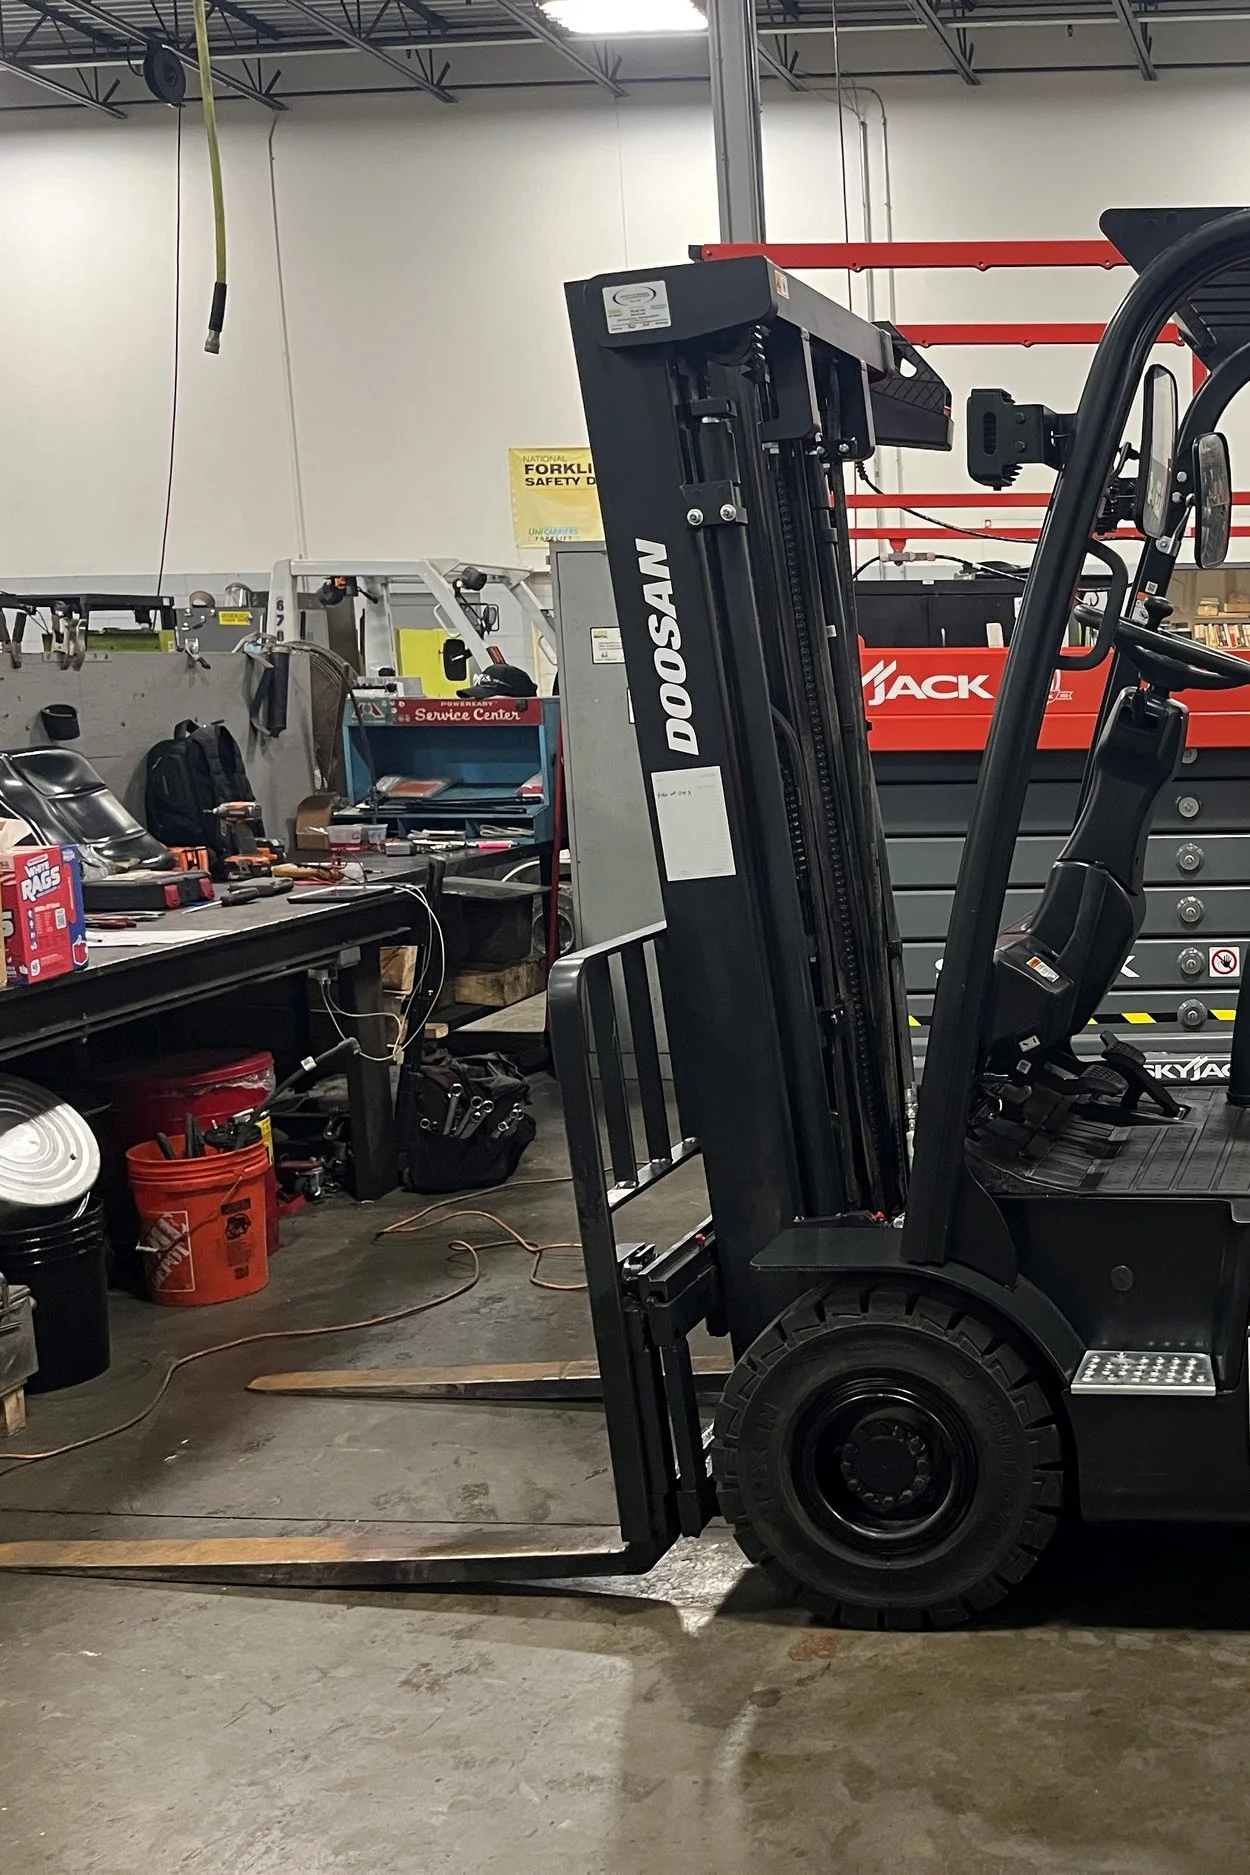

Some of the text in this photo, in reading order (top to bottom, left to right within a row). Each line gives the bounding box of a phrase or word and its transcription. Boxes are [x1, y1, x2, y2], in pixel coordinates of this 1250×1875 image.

[522, 455, 567, 463] NATIONAL
[524, 463, 592, 475] FORKLI
[525, 477, 596, 486] SAFETY D
[635, 538, 699, 755] DOOSAN
[862, 660, 995, 706] JACK
[414, 708, 520, 721] Service Center
[20, 875, 62, 902] RAGS
[1143, 1055, 1231, 1081] SKYJAC
